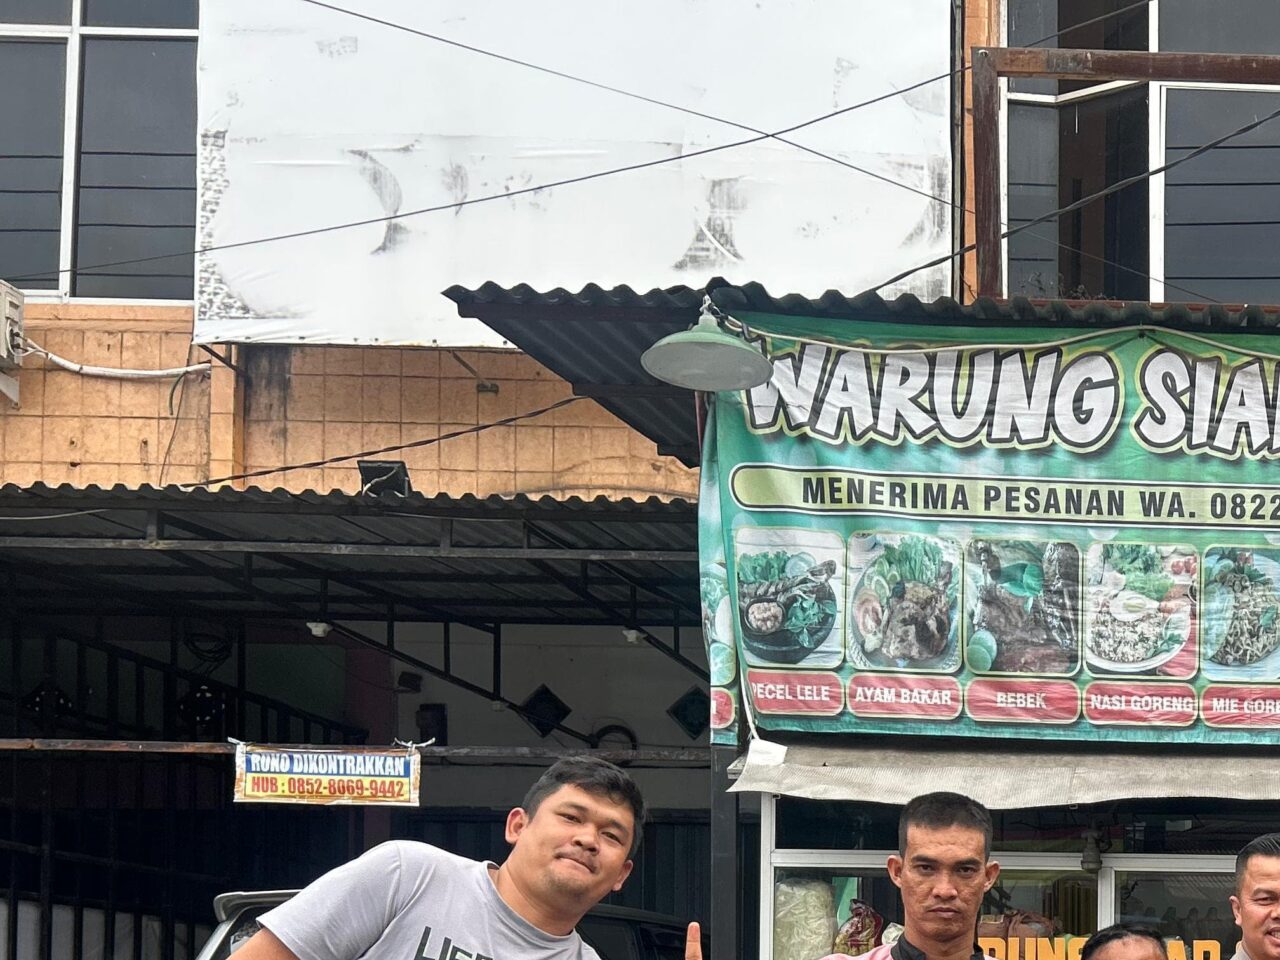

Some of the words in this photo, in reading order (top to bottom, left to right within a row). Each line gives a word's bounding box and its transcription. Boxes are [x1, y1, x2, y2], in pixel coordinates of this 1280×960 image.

[750, 345, 1120, 447] WARUNG
[802, 477, 970, 511] MENERIMA
[983, 485, 1125, 516] PESANAN
[1139, 490, 1196, 519] WA.
[797, 683, 830, 702] LELE
[855, 686, 896, 704] AYAM
[901, 689, 951, 705] BAKAR
[996, 692, 1046, 709] BEBEK
[1090, 695, 1126, 710] NASI
[1131, 696, 1193, 712] GORENG
[1212, 698, 1238, 713] MIE
[288, 777, 404, 798] 0852-8069-9442
